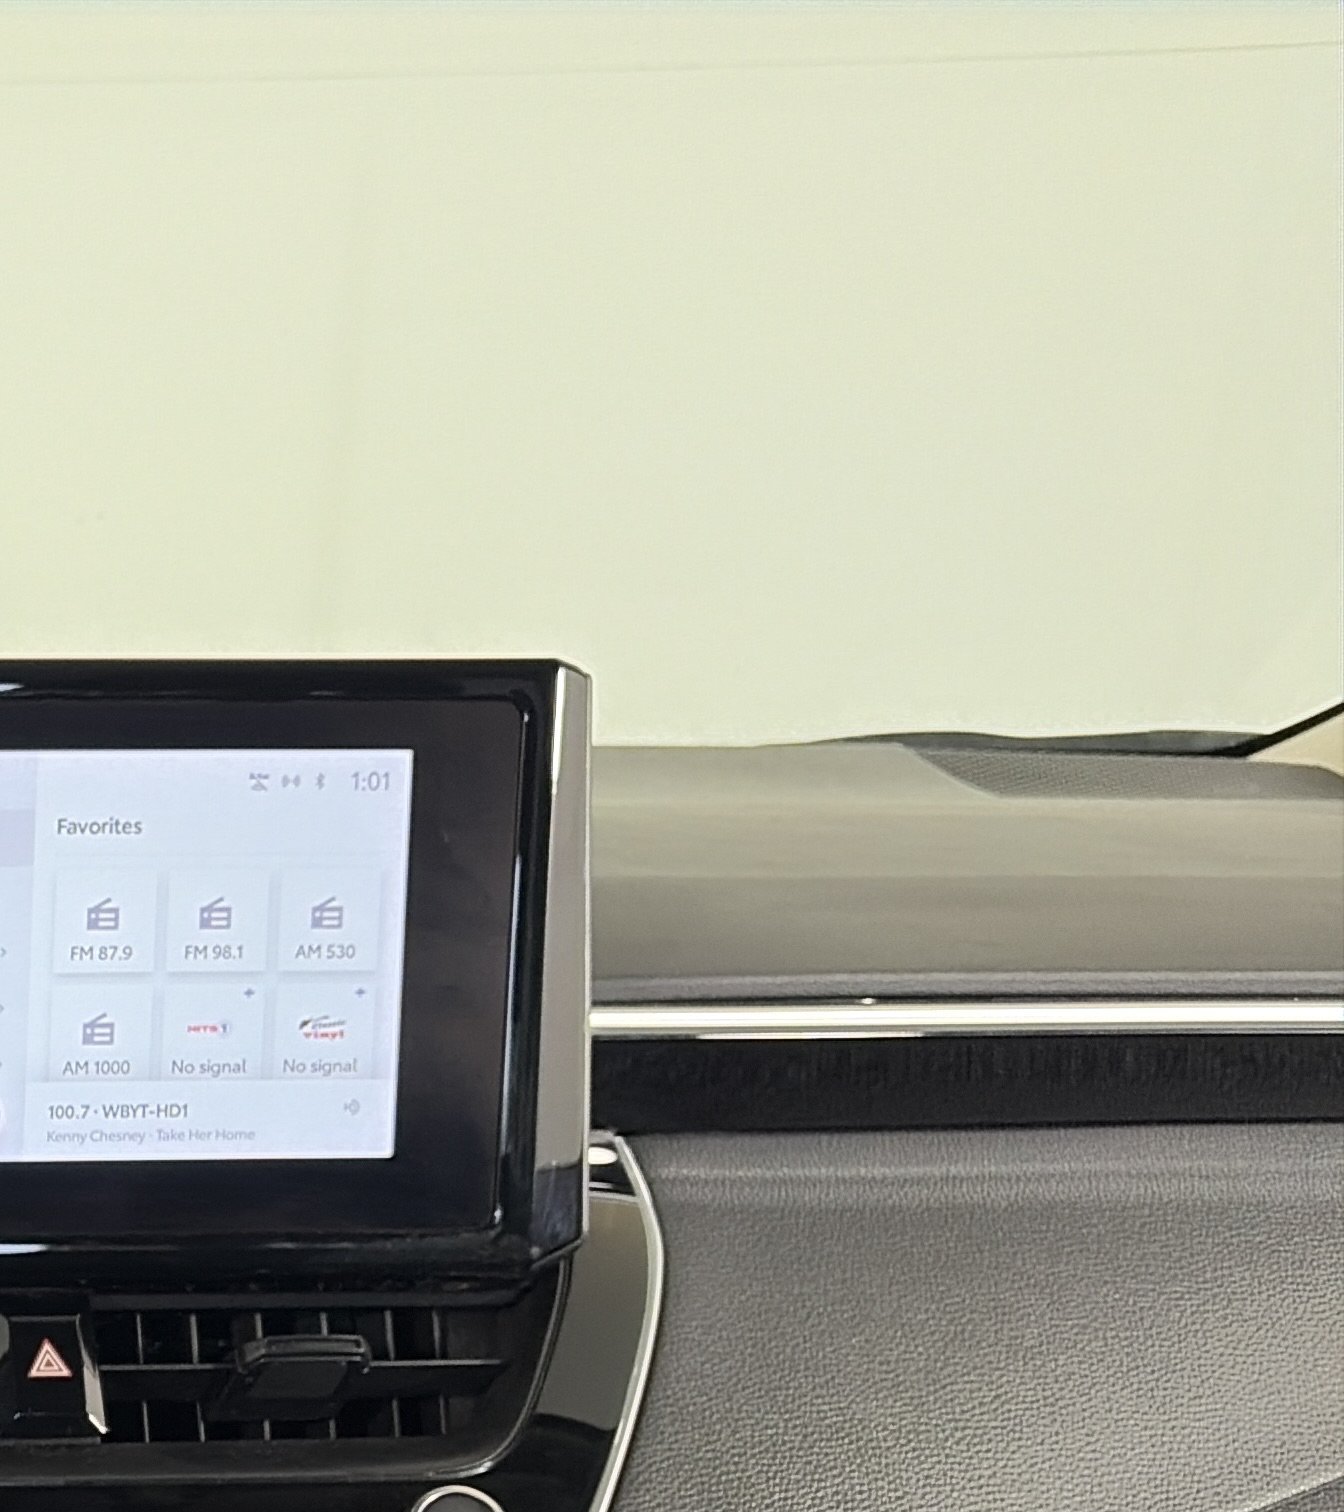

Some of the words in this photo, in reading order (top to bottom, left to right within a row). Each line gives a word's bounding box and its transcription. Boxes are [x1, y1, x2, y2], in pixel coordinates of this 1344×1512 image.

[351, 771, 391, 791] 1:01
[57, 816, 143, 835] Favorites
[70, 946, 94, 961] FM
[98, 945, 133, 960] 87.9
[184, 945, 208, 959] FM
[212, 945, 244, 959] 98.1
[294, 945, 322, 959] AM
[326, 944, 356, 959] 530
[62, 1061, 91, 1075] AM
[95, 1061, 130, 1075] 1000
[171, 1060, 195, 1074] No
[200, 1058, 247, 1077] signal
[282, 1060, 309, 1074] No
[311, 1058, 358, 1077] signal
[47, 1104, 90, 1120] 100.7
[103, 1103, 190, 1119] WBYT-HD1
[46, 1130, 88, 1144] Kenny
[90, 1130, 146, 1144] Chesney
[156, 1129, 185, 1142] Take
[188, 1129, 213, 1142] Her
[215, 1129, 257, 1142] Home
